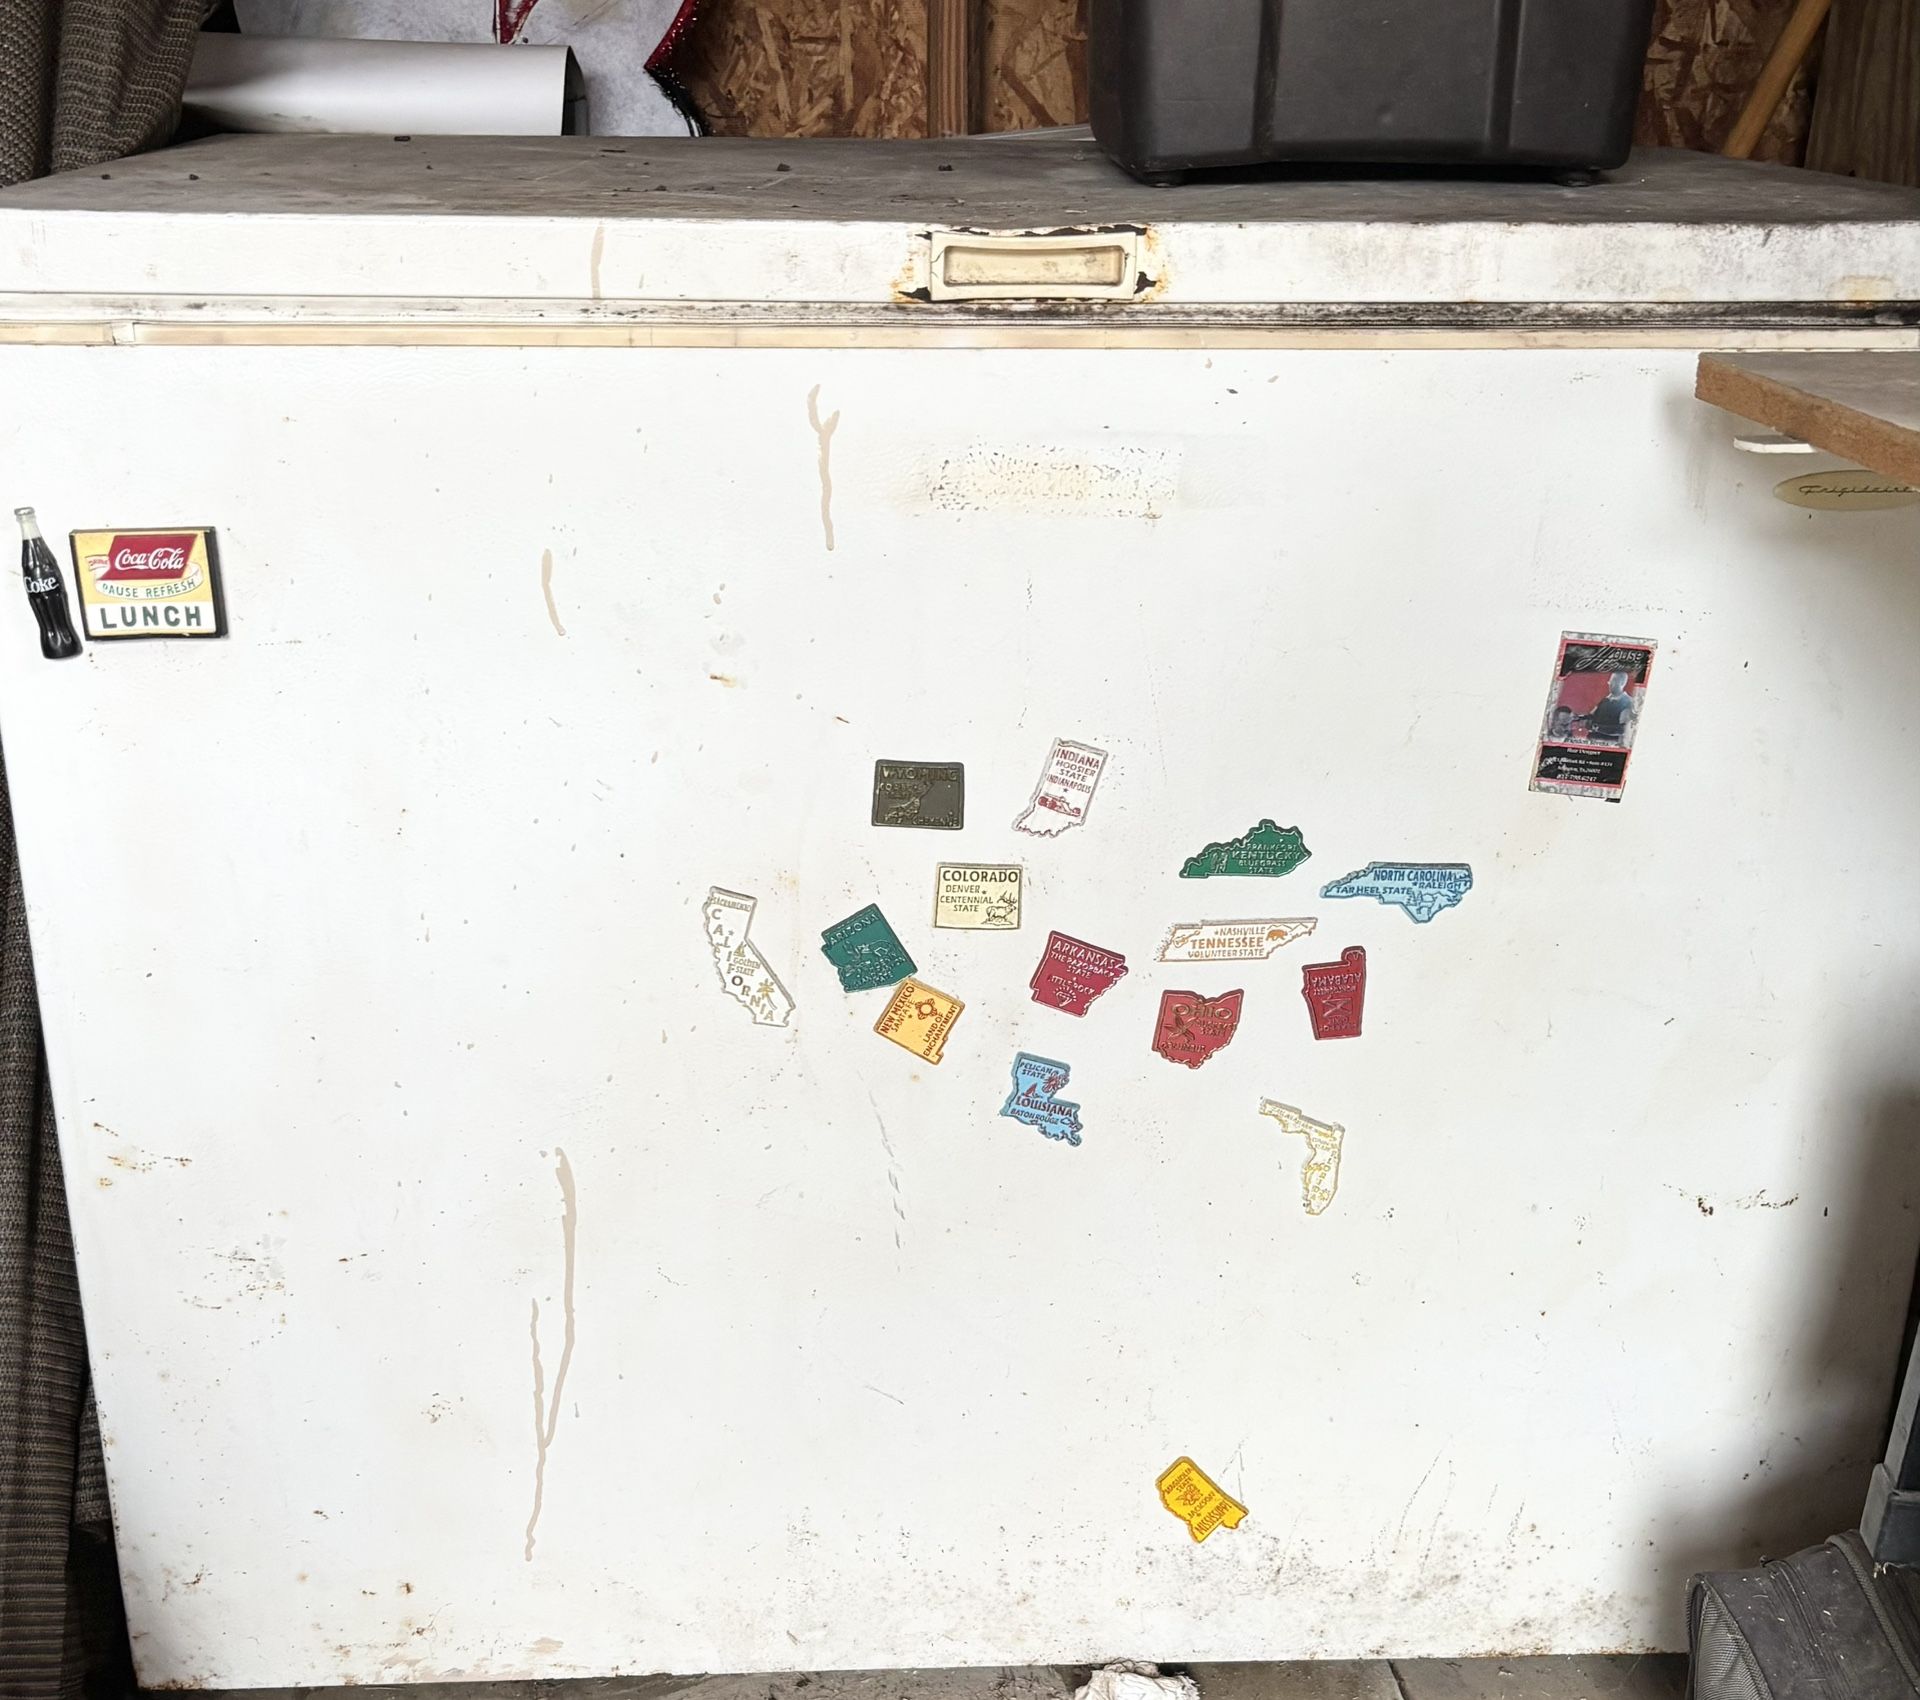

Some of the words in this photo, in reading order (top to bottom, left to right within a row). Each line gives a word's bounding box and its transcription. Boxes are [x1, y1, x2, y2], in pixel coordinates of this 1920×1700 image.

[114, 548, 186, 572] Coca-Cola
[24, 577, 59, 594] Coke
[103, 582, 139, 598] PAUSE
[146, 578, 197, 598] REFRESH
[101, 605, 203, 629] LUNCH
[1056, 748, 1100, 769] INDIANA
[1056, 760, 1097, 778] HOOSIER
[1059, 769, 1088, 783] STATE
[1046, 773, 1092, 794] INDIANAPOLIS
[1232, 851, 1301, 860] KENTUCKY
[942, 870, 1019, 883] COLORADO
[1373, 870, 1404, 882] NORTH
[1407, 870, 1458, 882] CAROLINA
[945, 884, 981, 893] DENVER
[1355, 887, 1381, 895] HEEL
[1382, 887, 1414, 895] STATE
[1419, 882, 1462, 890] RALEIGH
[940, 895, 994, 904] CENTENNIAL
[953, 904, 980, 912] STATE
[830, 913, 880, 945] ARIZONA
[1219, 926, 1266, 937] NASHVILLE
[1190, 937, 1265, 949] TENNESSEE
[1050, 951, 1067, 963] THE
[1052, 940, 1116, 969] ARKANSAS
[1187, 949, 1238, 958] VOLUNTEER
[1238, 949, 1265, 957] STATE
[1066, 965, 1093, 978] STATE
[1311, 972, 1362, 987] ALABAMA
[879, 1014, 897, 1034] NEW
[893, 985, 915, 1017] MEXICO
[891, 1008, 909, 1032] SANTA
[906, 999, 916, 1010] FE
[1172, 1003, 1233, 1020] OHIO
[923, 1022, 938, 1043] LAND
[934, 1012, 945, 1025] OF
[923, 1004, 958, 1057] ENCHANTMENT
[1020, 1061, 1053, 1074] PELICAN
[1022, 1069, 1046, 1080] STATE
[1015, 1095, 1073, 1117] LOUISIANA
[1010, 1108, 1035, 1119] BATON
[1034, 1112, 1060, 1125] ROUGE
[1187, 1491, 1215, 1519] JACKSON
[1194, 1500, 1233, 1536] MISSISSIPPI
